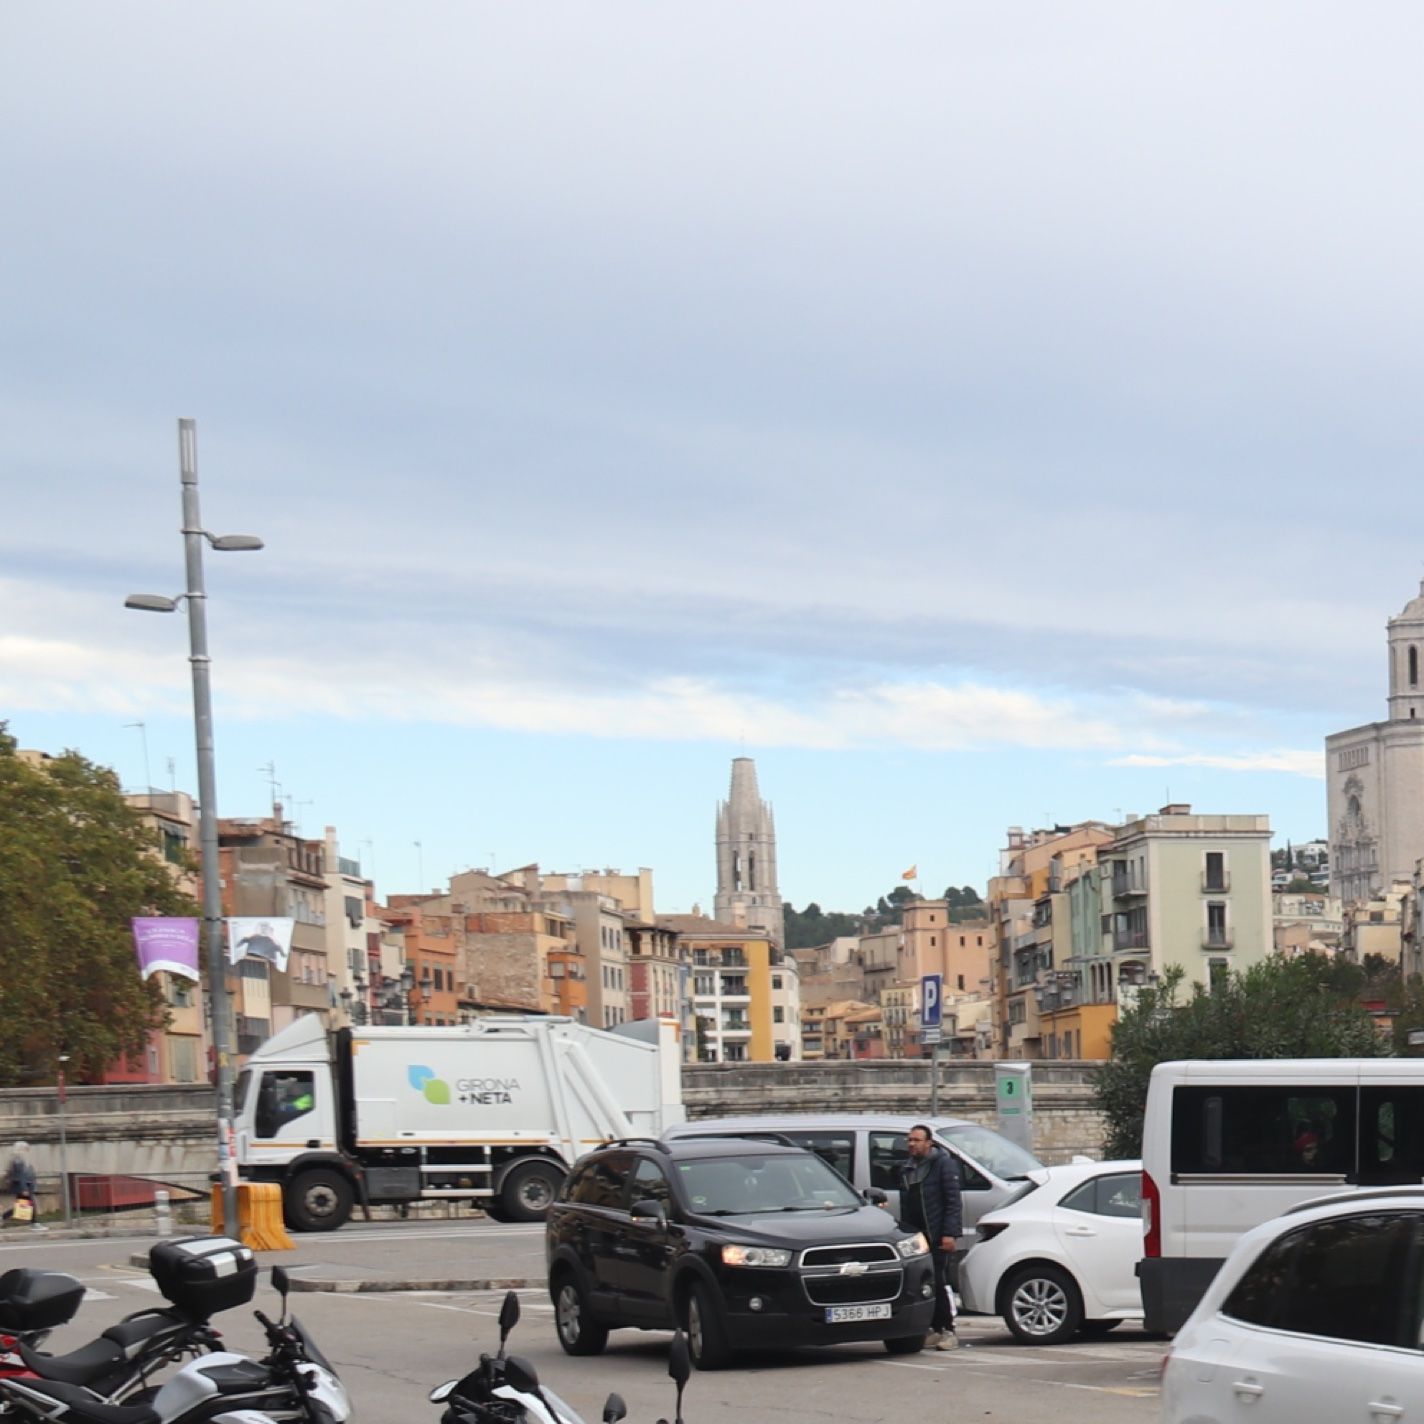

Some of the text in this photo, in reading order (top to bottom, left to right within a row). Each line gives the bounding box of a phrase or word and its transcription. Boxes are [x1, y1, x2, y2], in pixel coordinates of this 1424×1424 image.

[925, 980, 937, 1022] P
[456, 1078, 521, 1092] GIRONA
[1006, 1081, 1014, 1095] 3
